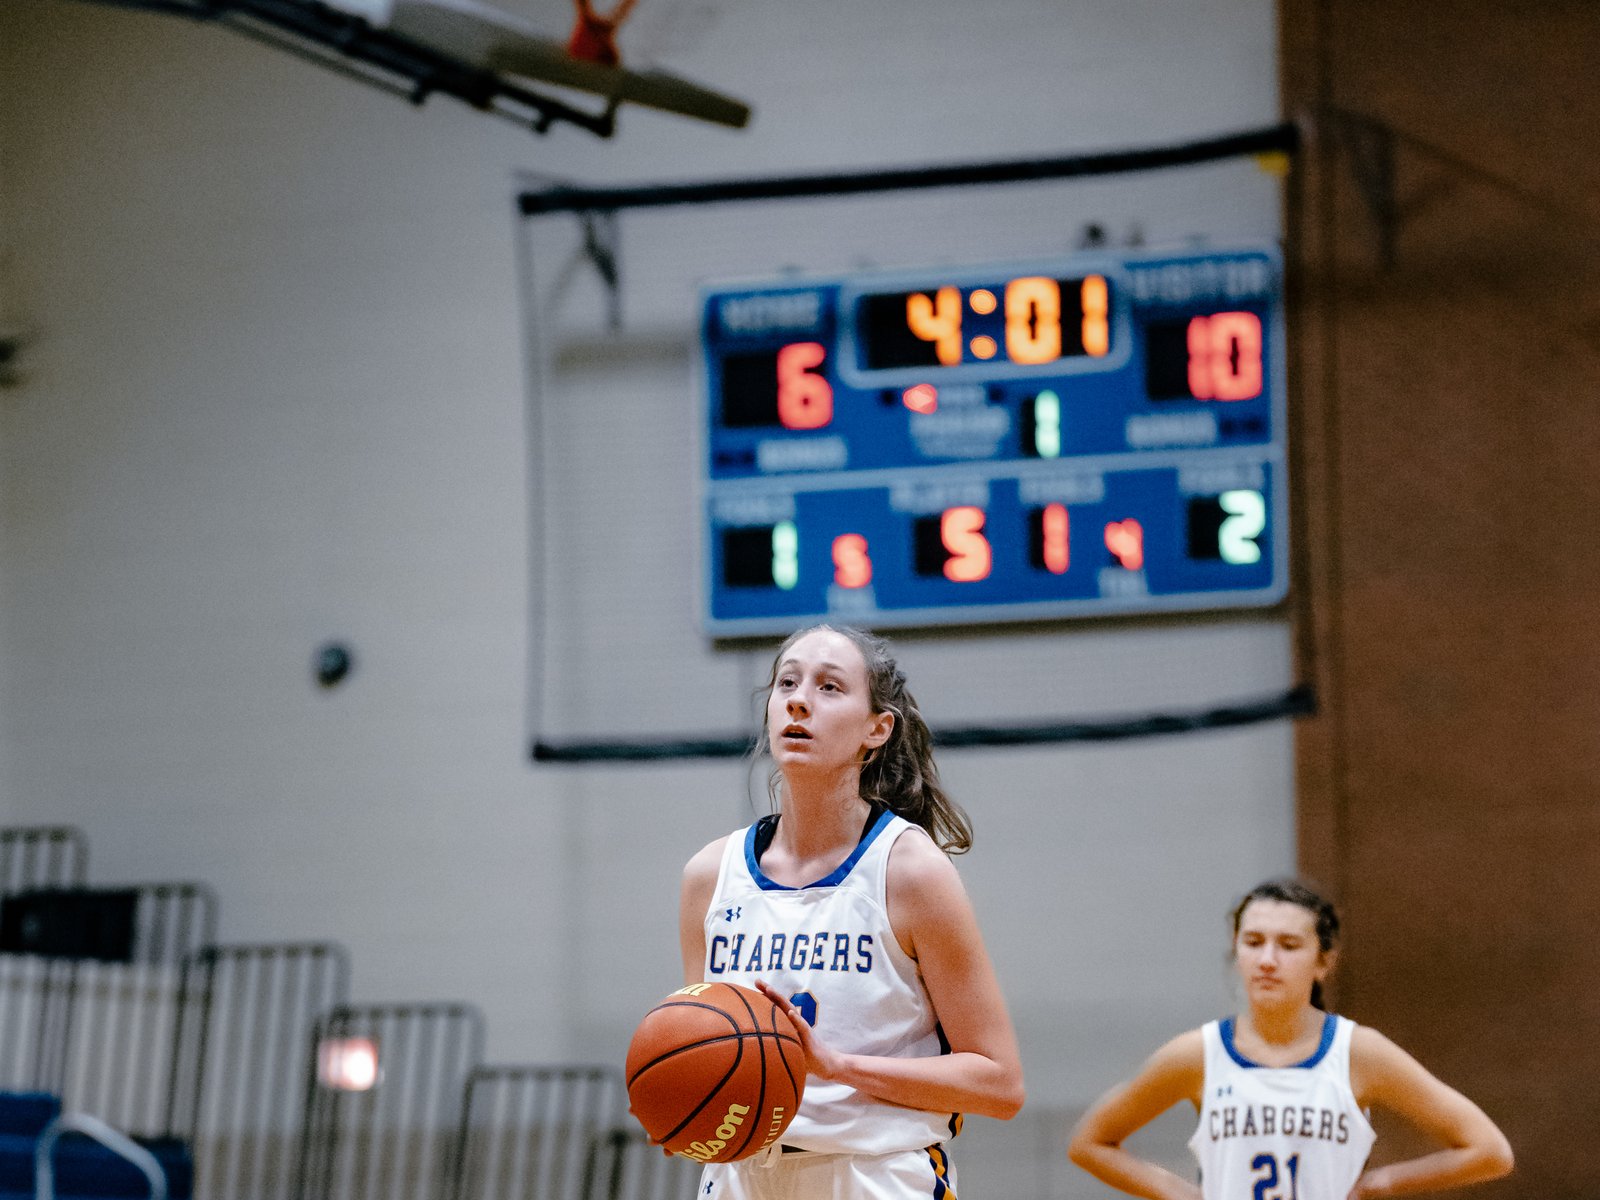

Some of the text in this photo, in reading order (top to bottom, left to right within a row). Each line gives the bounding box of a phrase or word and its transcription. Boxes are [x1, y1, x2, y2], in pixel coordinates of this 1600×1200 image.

[906, 275, 1109, 366] 4:01
[1187, 311, 1262, 401] 10
[777, 342, 833, 430] 6
[1035, 389, 1061, 458] 1
[772, 520, 798, 590] 1
[940, 506, 992, 582] 5
[1043, 502, 1069, 574] 1
[1218, 490, 1265, 565] 2
[709, 932, 874, 975] CHARGERS
[681, 1103, 750, 1162] ilson
[1208, 1105, 1350, 1144] CHARGERS
